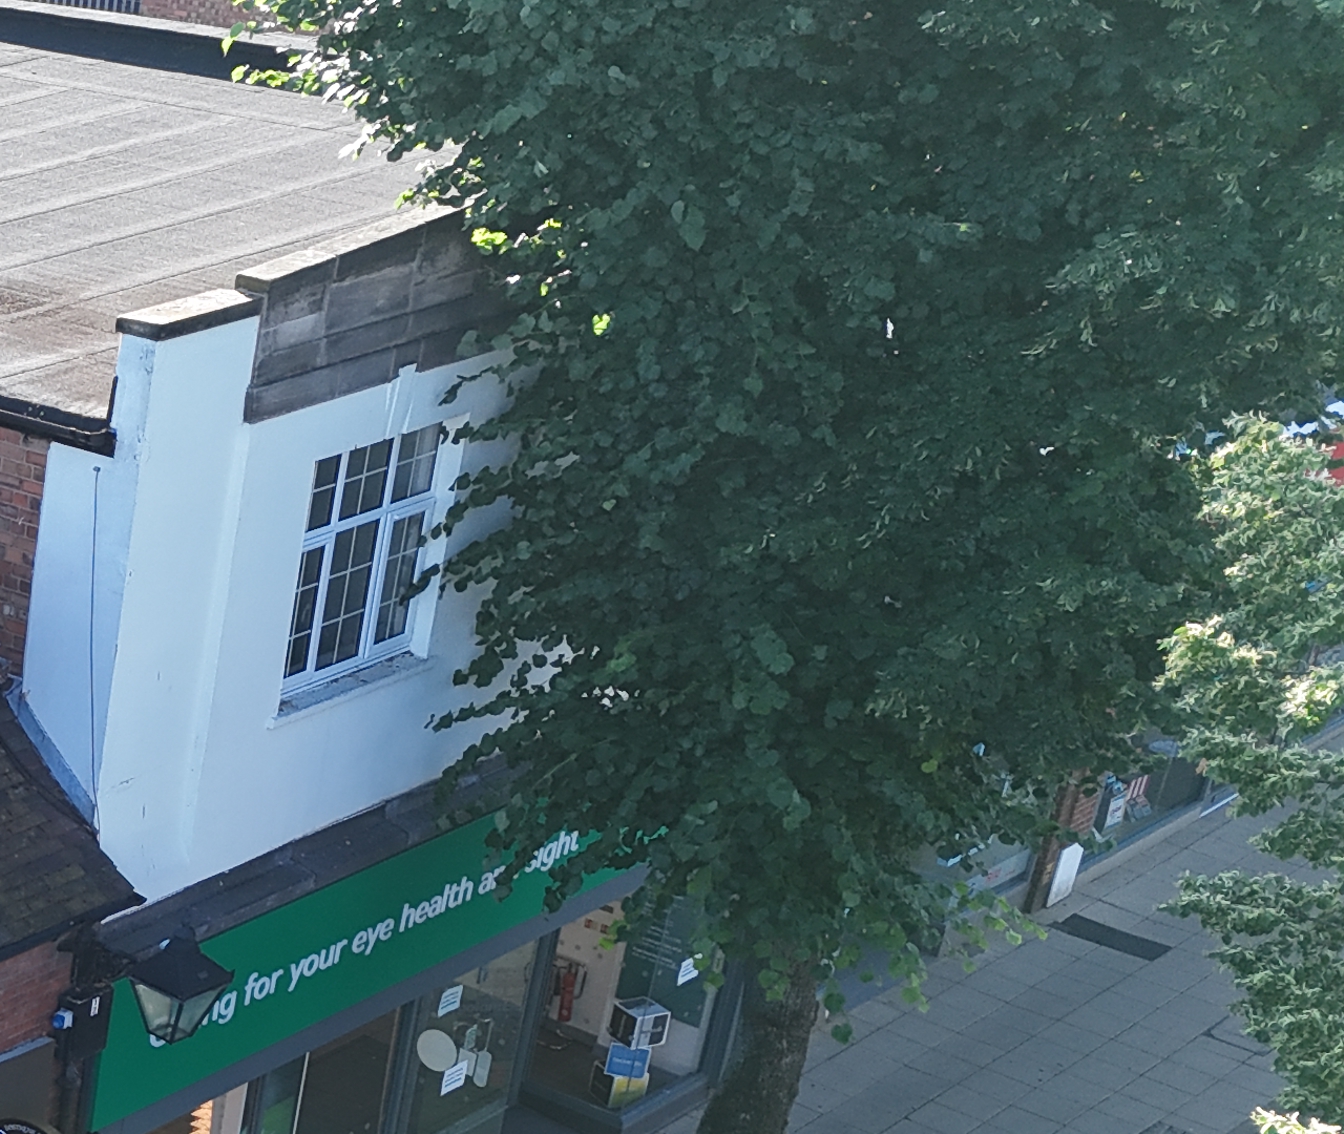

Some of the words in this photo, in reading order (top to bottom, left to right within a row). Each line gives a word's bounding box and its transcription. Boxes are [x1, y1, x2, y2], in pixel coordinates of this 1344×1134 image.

[243, 965, 284, 1006] for
[287, 938, 349, 991] your
[351, 918, 393, 956] eye
[398, 875, 474, 933] health
